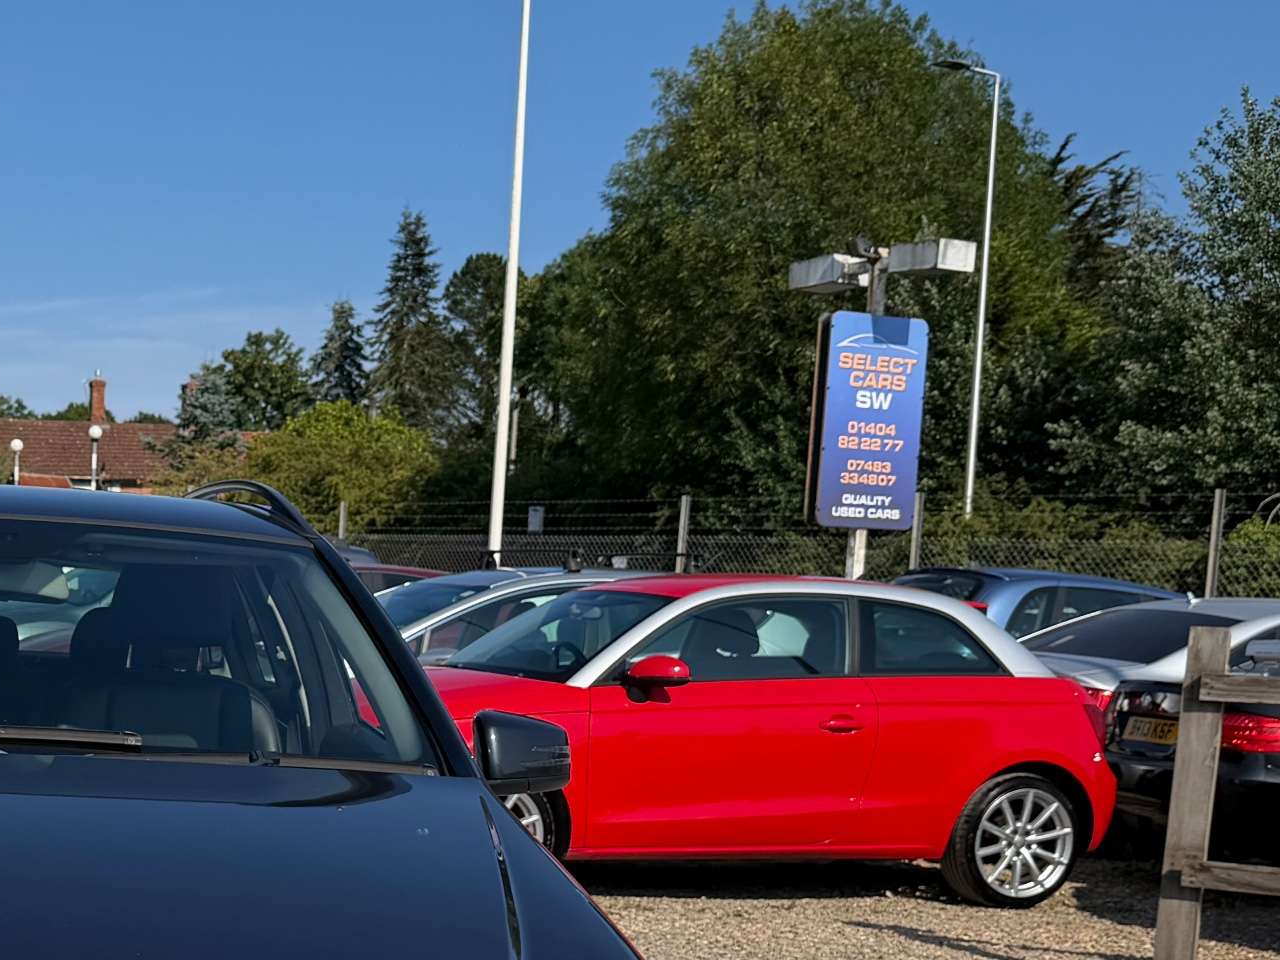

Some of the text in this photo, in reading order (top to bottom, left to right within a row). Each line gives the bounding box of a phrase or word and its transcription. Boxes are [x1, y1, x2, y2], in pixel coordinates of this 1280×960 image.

[838, 352, 918, 375] SELECT
[849, 370, 907, 392] CARS
[855, 390, 893, 411] SW
[847, 420, 897, 437] 01404
[847, 459, 893, 474] 07483
[840, 472, 897, 487] 334807
[841, 493, 892, 507] QUALITY
[831, 506, 901, 521] USED CARS
